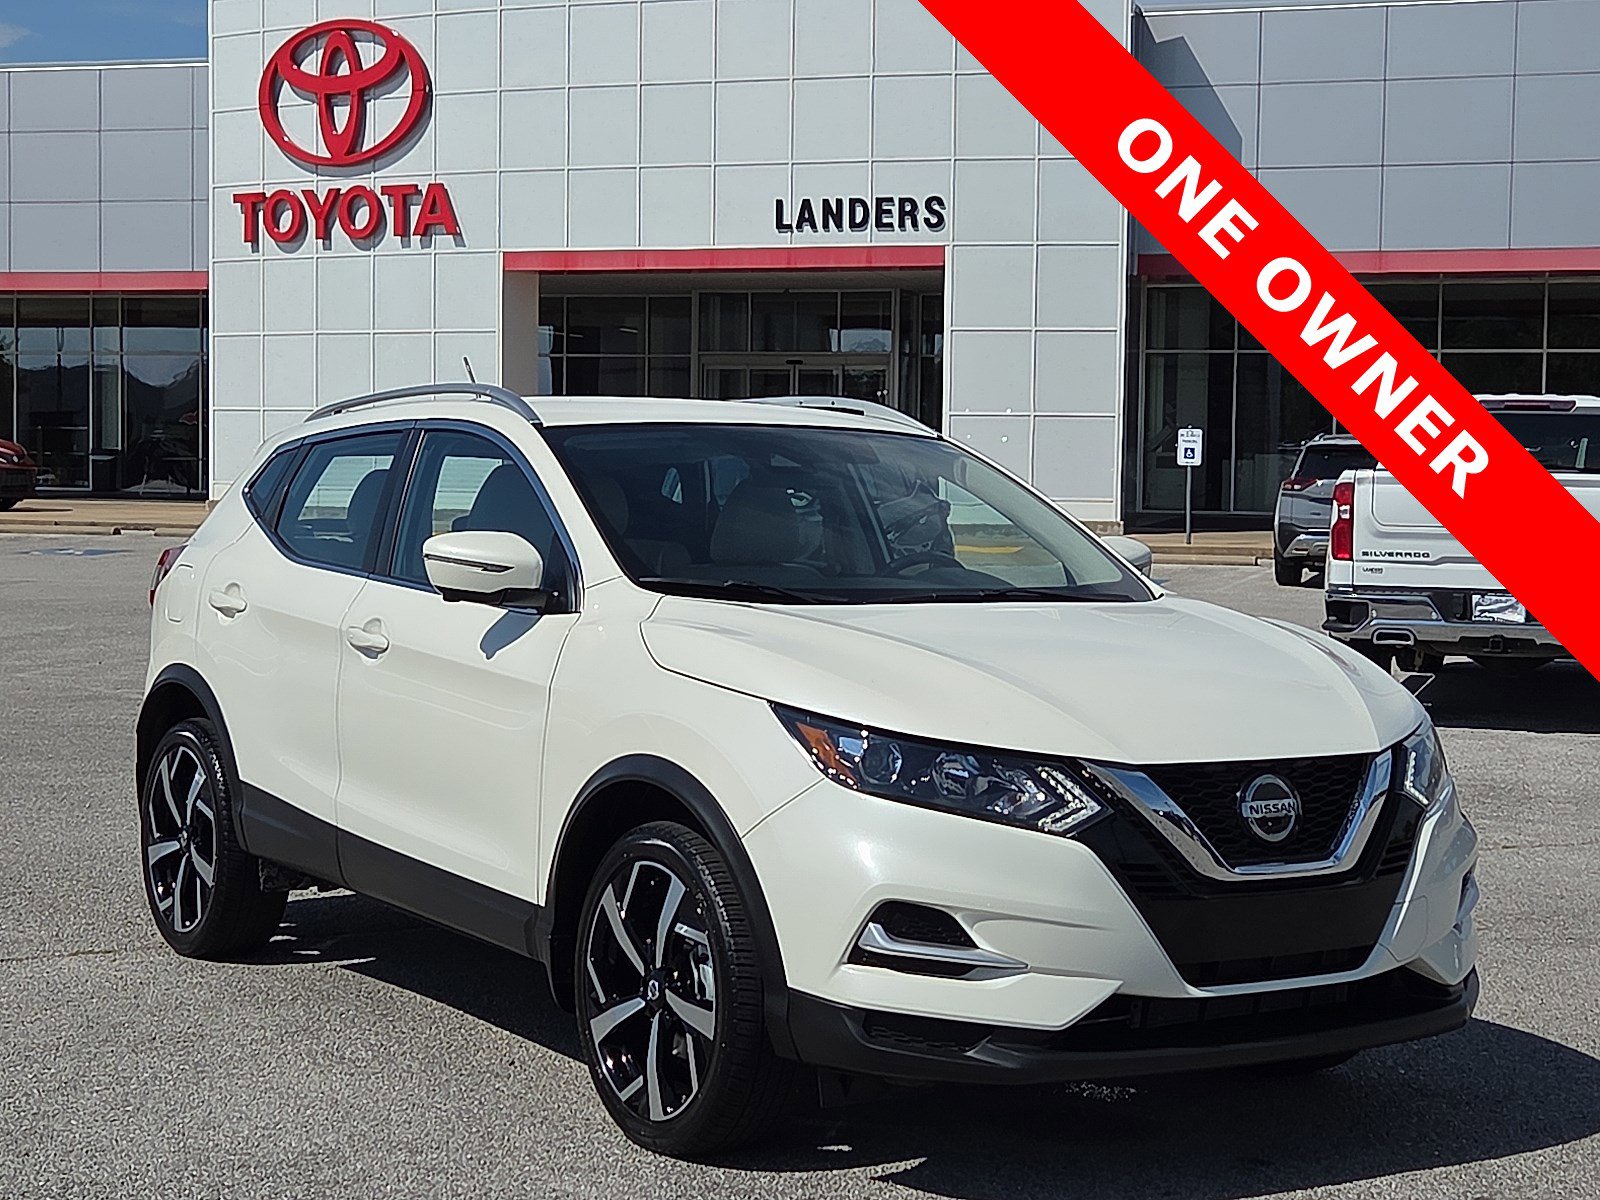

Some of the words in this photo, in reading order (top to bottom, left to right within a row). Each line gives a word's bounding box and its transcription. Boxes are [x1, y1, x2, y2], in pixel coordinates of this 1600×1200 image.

[233, 183, 461, 245] TOYOTA
[775, 196, 947, 234] LANDERS
[1361, 550, 1431, 559] SILVERADO
[1248, 801, 1296, 815] NISSAN
